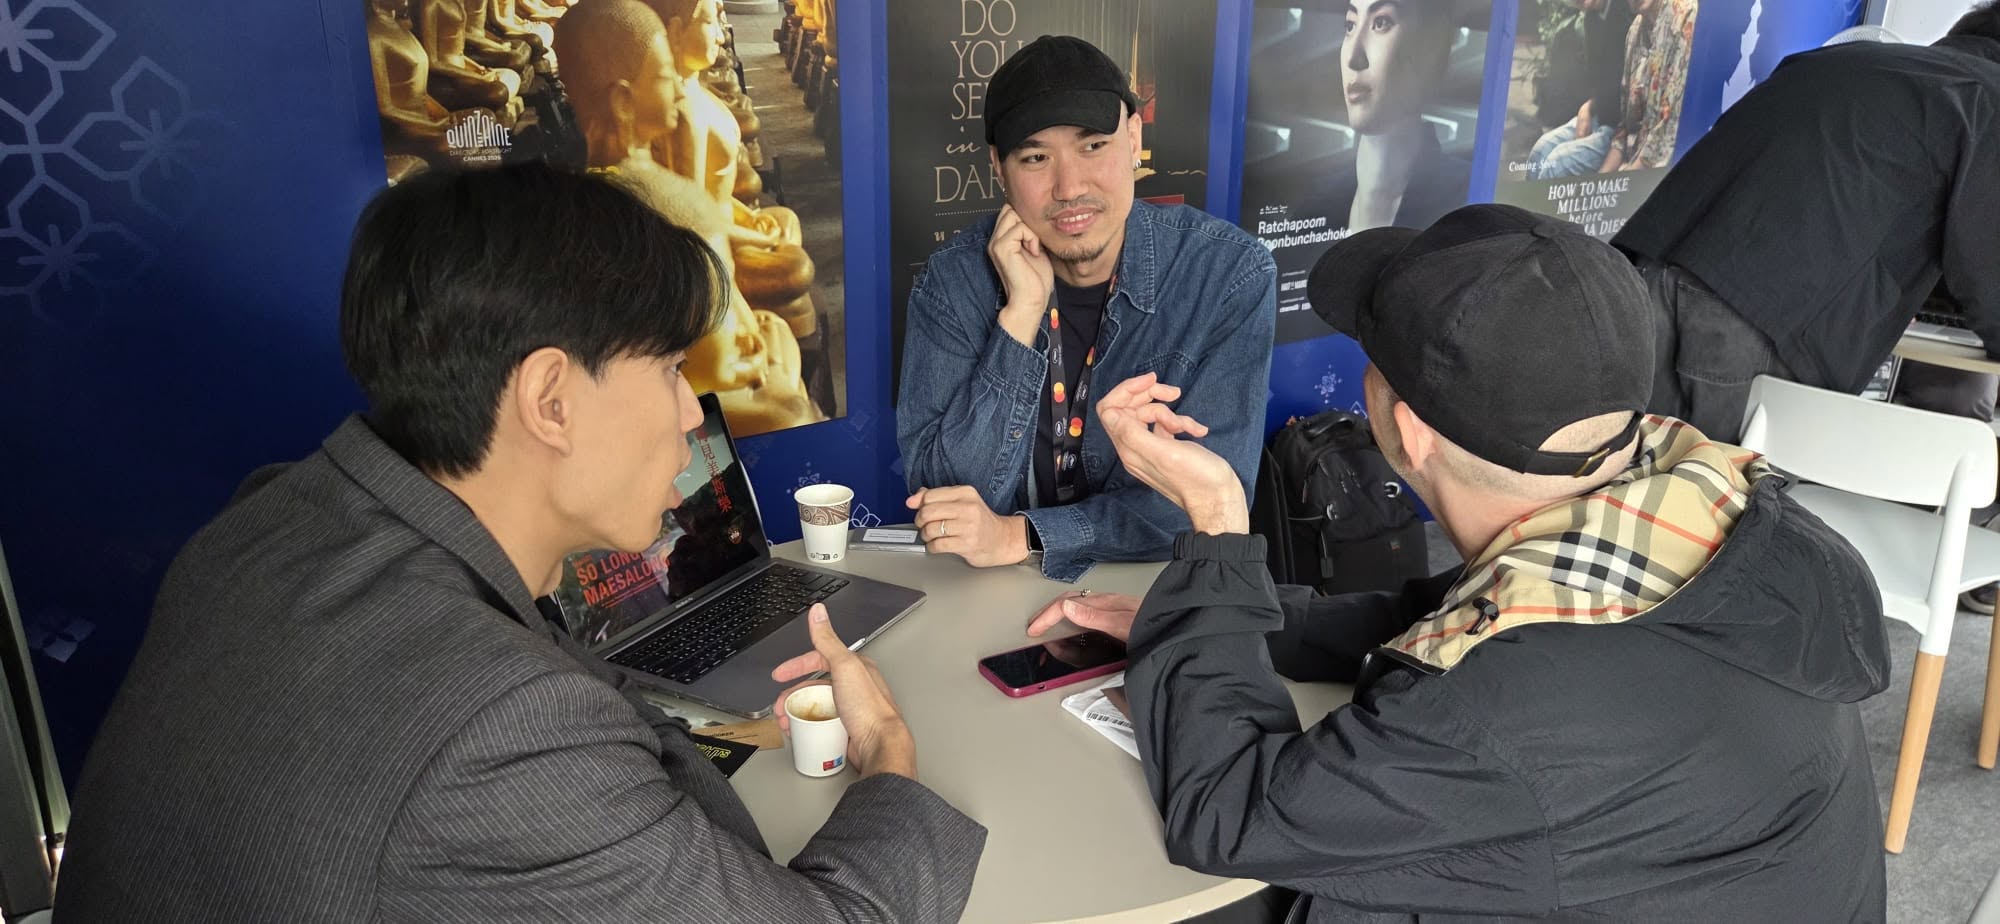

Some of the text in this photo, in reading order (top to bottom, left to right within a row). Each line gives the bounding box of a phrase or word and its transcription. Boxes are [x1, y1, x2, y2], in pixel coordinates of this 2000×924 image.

[960, 0, 1017, 36] DO
[951, 82, 991, 120] SE
[1508, 160, 1537, 173] Coming
[1548, 177, 1630, 201] HOW TO MAKE
[1557, 194, 1619, 215] MILLIONS
[1258, 216, 1327, 235] Ratchapoom
[1568, 212, 1604, 225] before
[576, 563, 599, 586] SO
